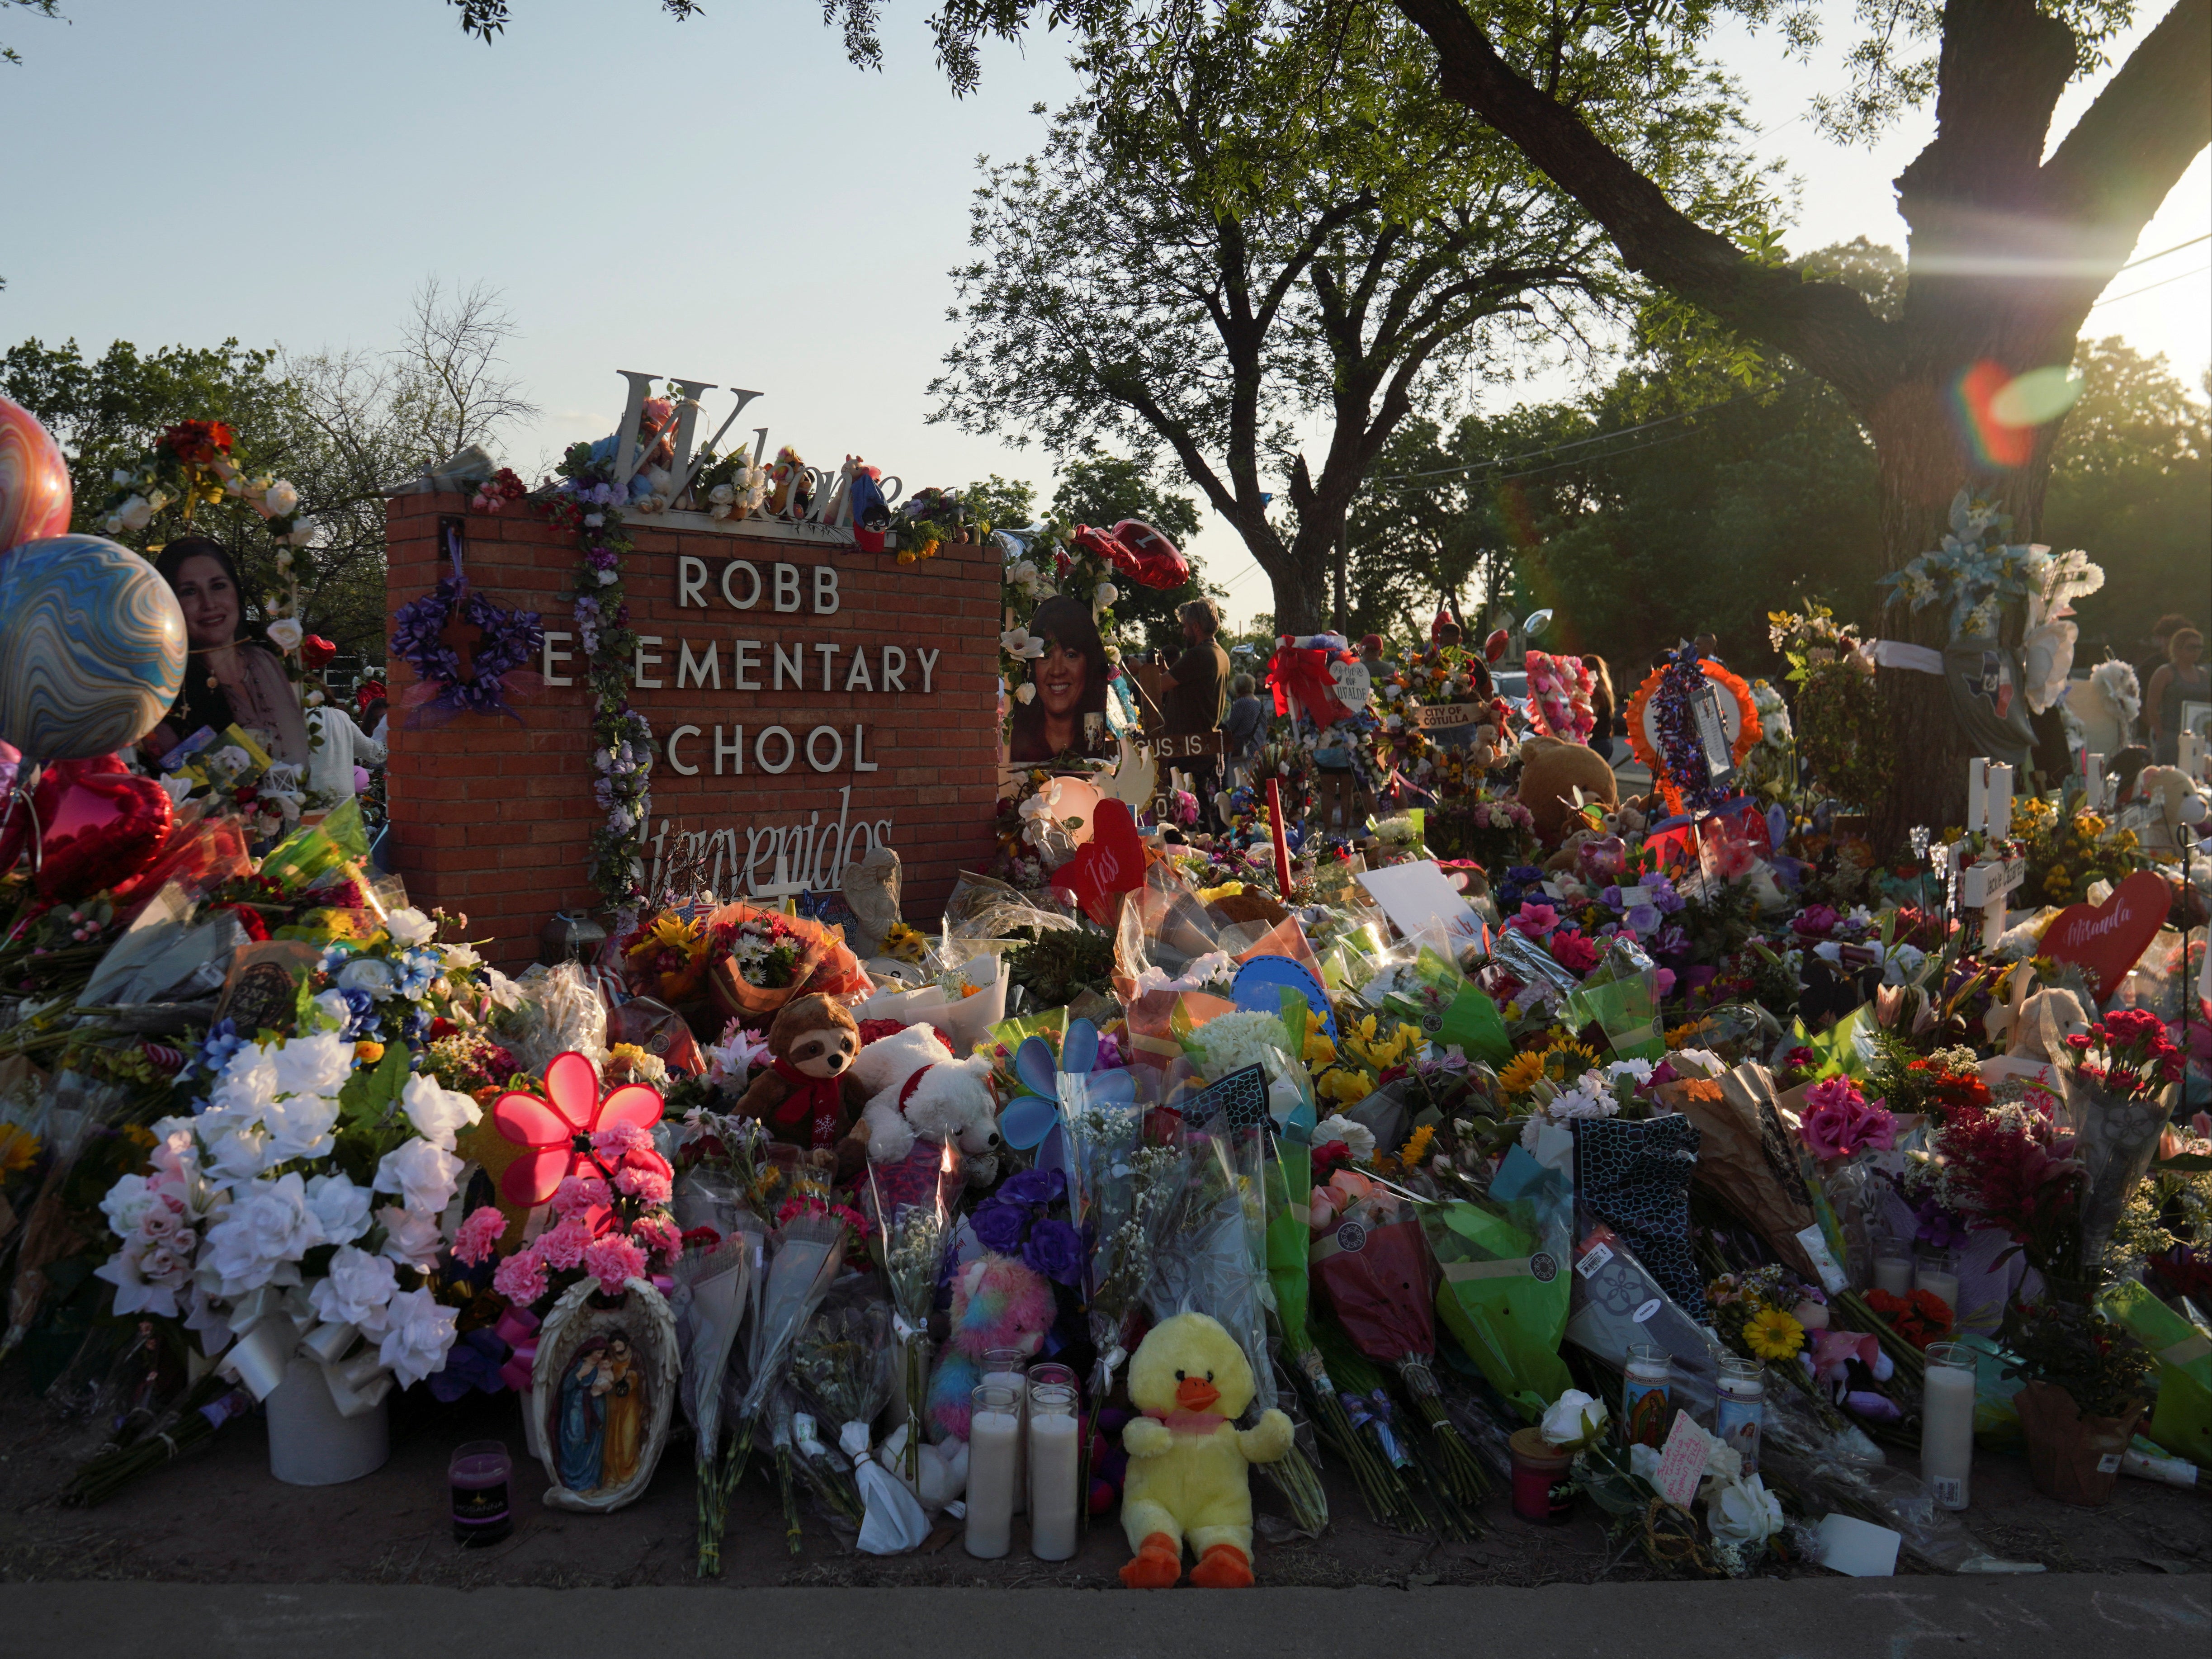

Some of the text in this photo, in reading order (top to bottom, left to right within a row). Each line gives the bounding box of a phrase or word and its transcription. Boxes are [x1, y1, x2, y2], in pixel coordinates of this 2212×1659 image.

[614, 370, 902, 530] Wlcome
[679, 556, 839, 614] ROBB
[543, 632, 940, 694] EEMENTARY
[1337, 687, 1366, 700] UVALDE
[1424, 714, 1469, 725] COTULLA
[1425, 706, 1461, 716] CITY OF
[644, 724, 878, 775] CHOOL
[1116, 735, 1202, 760] JSUS IS
[634, 785, 892, 907] ienvenidos
[1085, 846, 1119, 901] Tess
[1986, 872, 2002, 897] Jackie
[2062, 897, 2132, 947] Miranda
[1640, 1304, 1654, 1316] RAINBOW
[1666, 1479, 1676, 1496] you
[456, 1501, 504, 1512] HOSANNA
